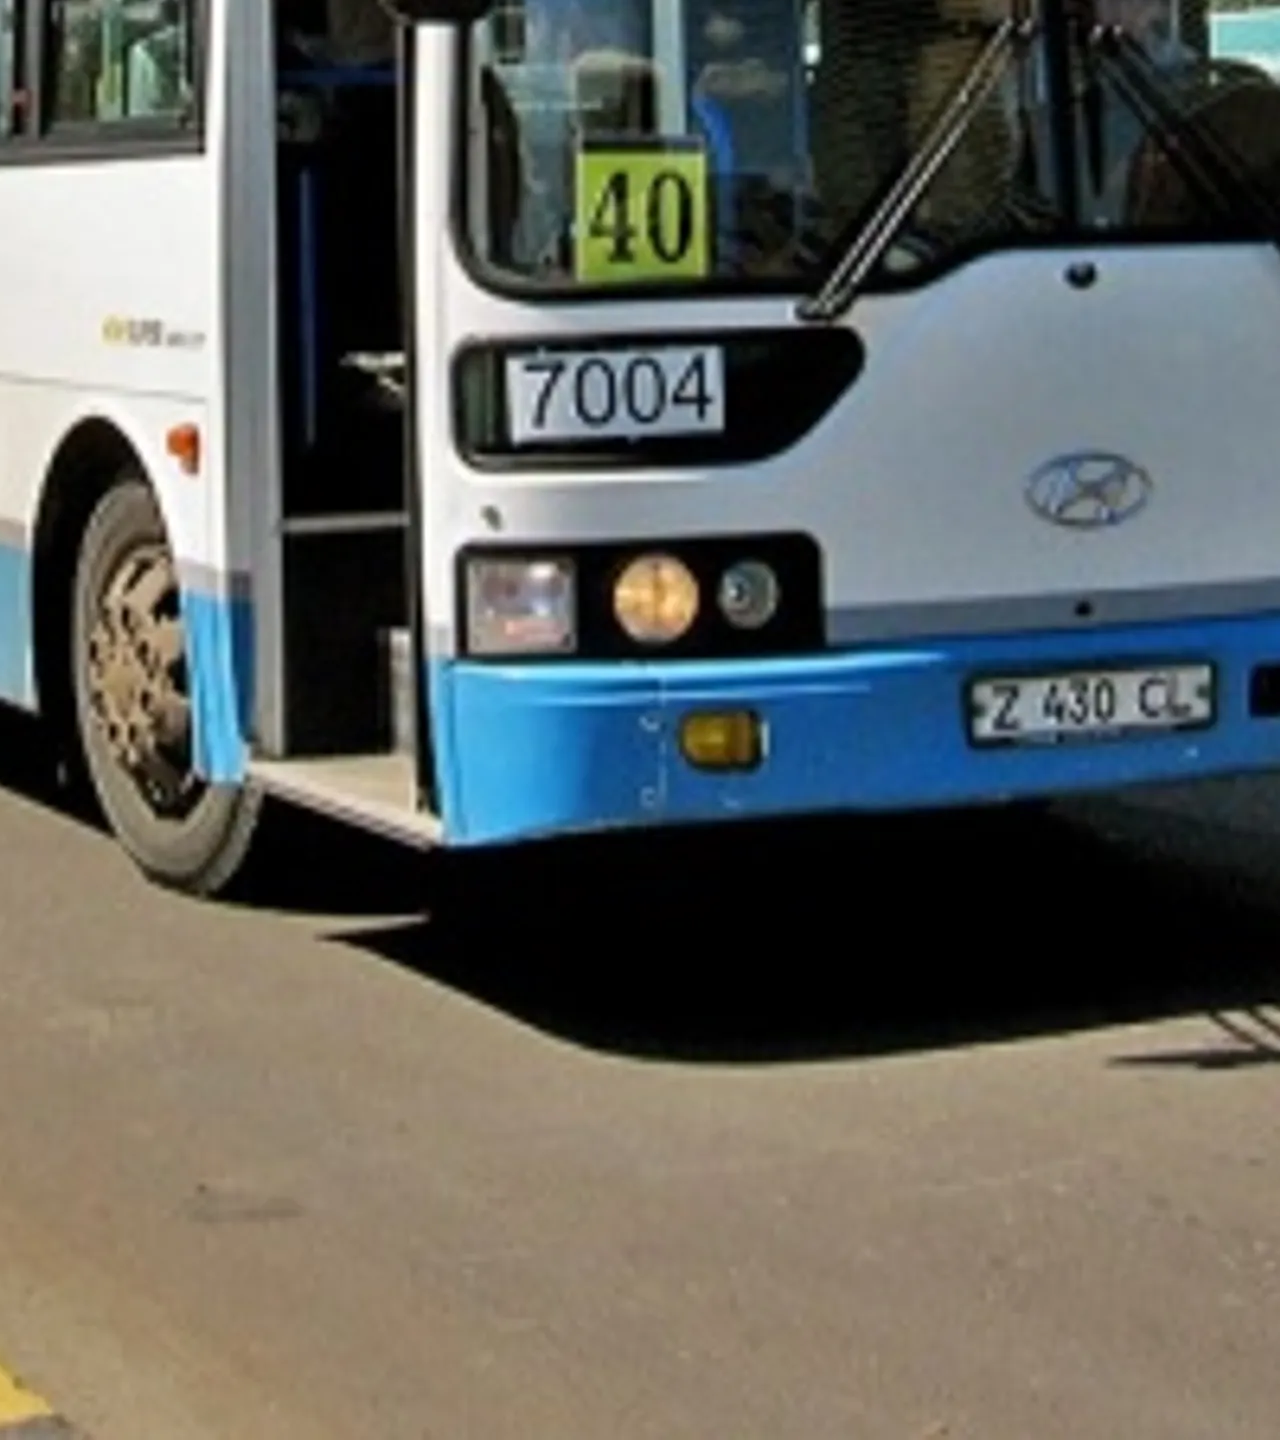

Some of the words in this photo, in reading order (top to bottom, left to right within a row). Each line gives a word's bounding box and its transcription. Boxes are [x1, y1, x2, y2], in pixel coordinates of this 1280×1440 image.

[587, 169, 693, 264] 40
[523, 353, 712, 429] 7004
[990, 685, 1019, 731] Z
[1044, 677, 1116, 726] 430
[1138, 675, 1192, 718] CL
